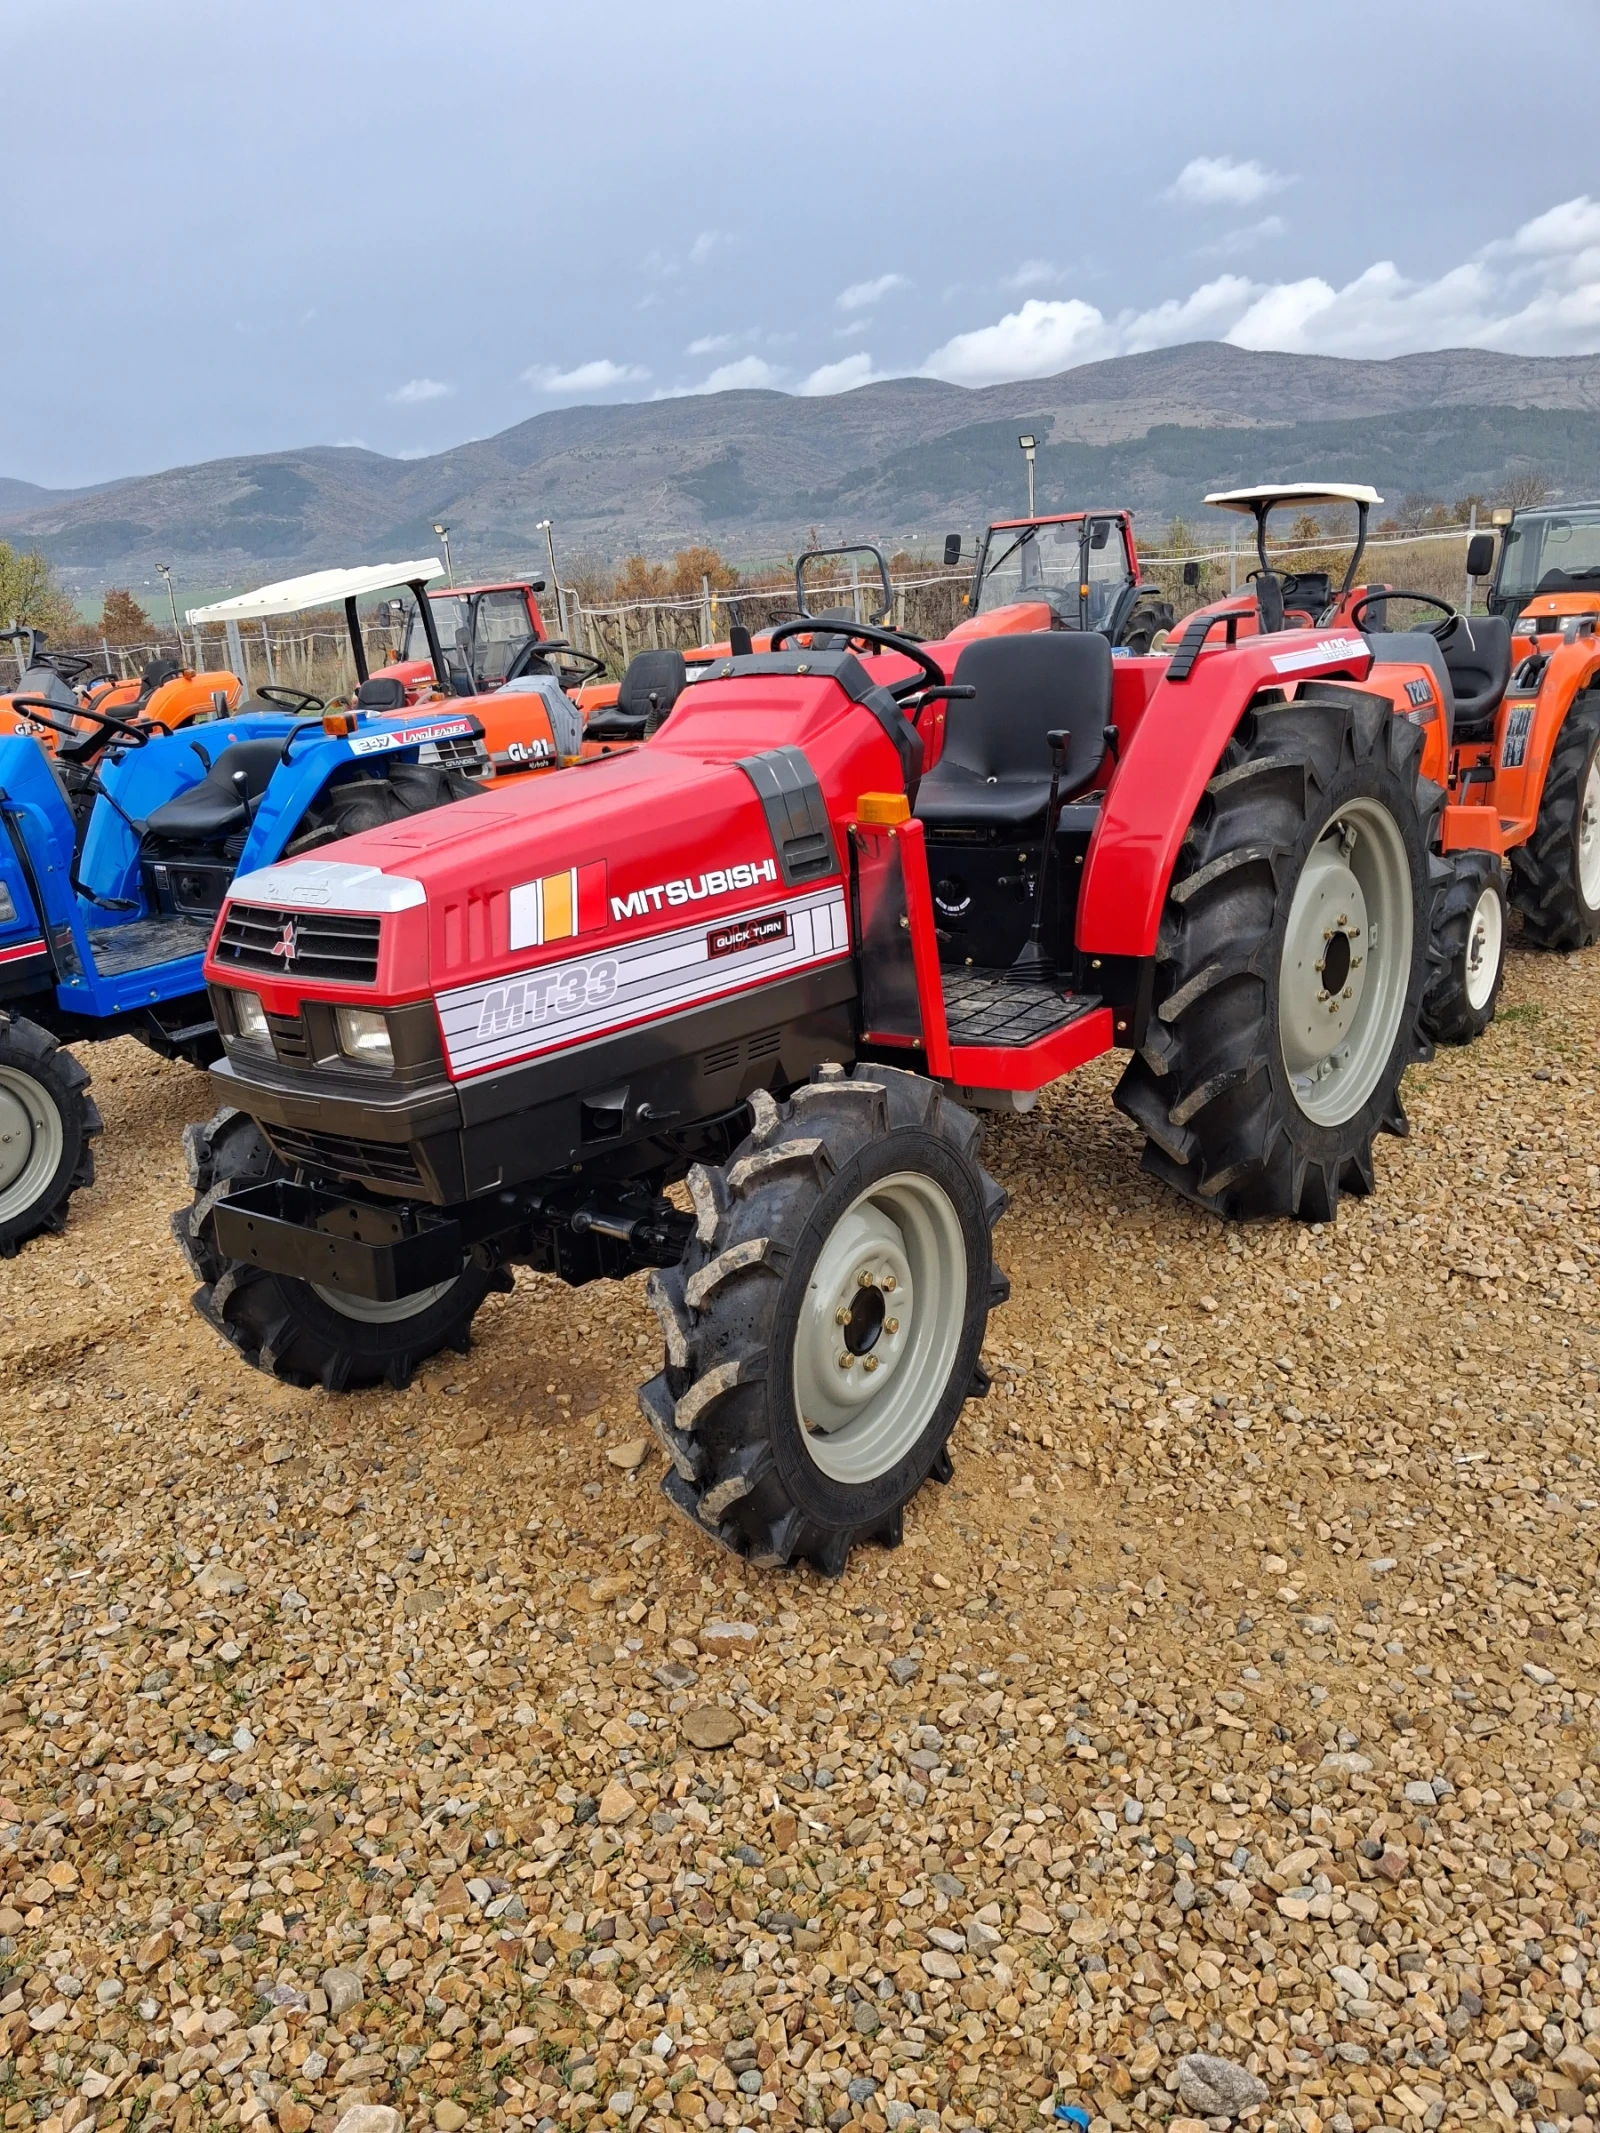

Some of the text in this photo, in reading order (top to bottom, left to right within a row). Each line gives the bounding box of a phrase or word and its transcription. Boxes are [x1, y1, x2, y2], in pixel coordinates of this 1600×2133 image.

[358, 735, 390, 751] 247
[508, 738, 549, 762] GL-21
[610, 858, 778, 921] MITSUBISHI
[716, 921, 782, 948] QUICK TURN
[476, 958, 620, 1039] MT33
